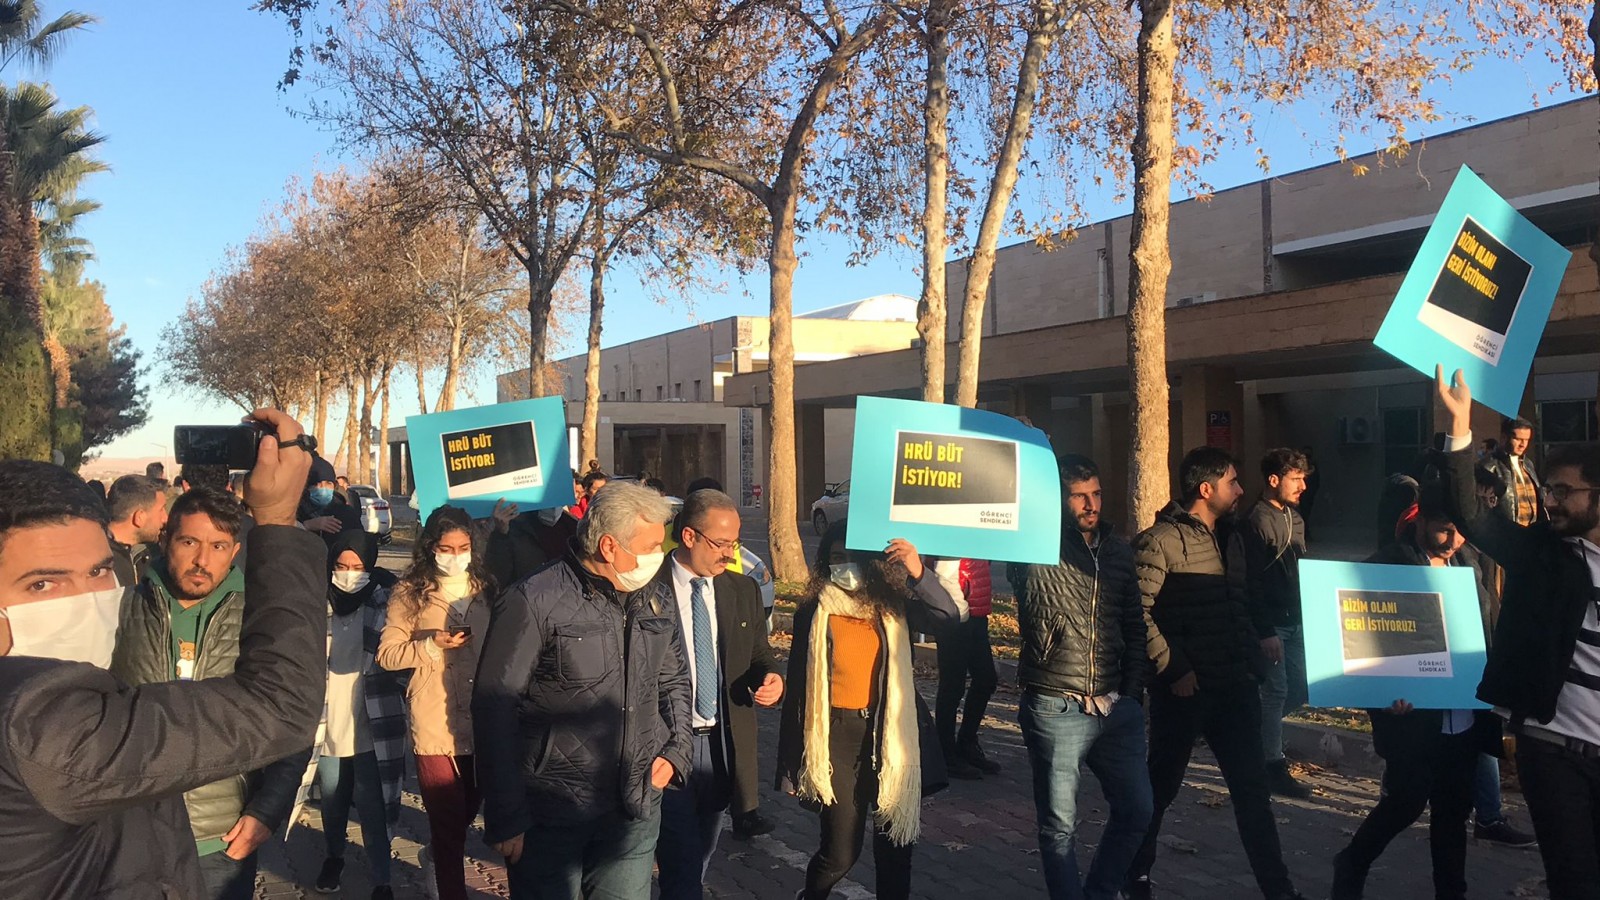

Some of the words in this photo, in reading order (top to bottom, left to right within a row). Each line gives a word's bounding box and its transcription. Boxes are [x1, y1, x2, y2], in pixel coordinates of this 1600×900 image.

[1457, 231, 1479, 257] BİZİM
[1474, 245, 1498, 271] OLANI
[1447, 253, 1468, 276] GERİ
[1461, 261, 1499, 300] İSTİYORUZ!
[1210, 413, 1217, 424] P
[447, 435, 470, 454] HRÜ
[472, 433, 492, 450] BÜT
[904, 440, 933, 461] HRÜ
[937, 443, 964, 463] BÜT
[450, 452, 496, 472] İSTİYOR!
[902, 465, 963, 489] İSTİYOR!
[1342, 598, 1368, 613] BİZİM
[1370, 601, 1398, 614] OLANI
[1344, 617, 1366, 631] GERİ
[1367, 617, 1417, 632] İSTİYORUZ!
